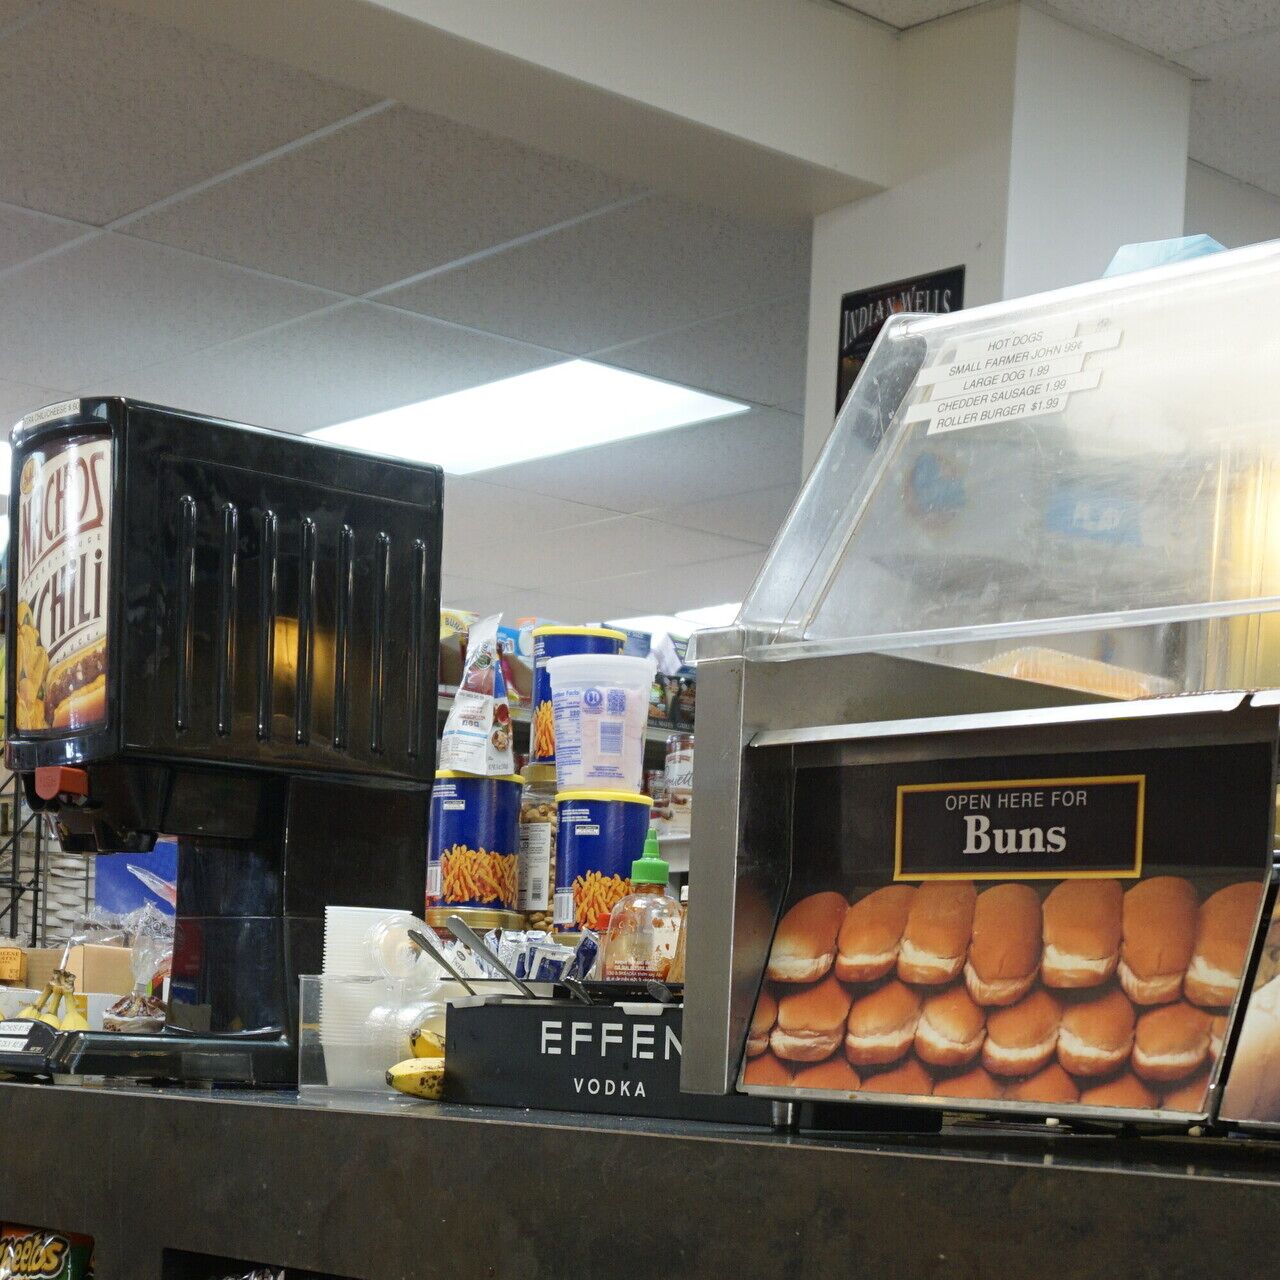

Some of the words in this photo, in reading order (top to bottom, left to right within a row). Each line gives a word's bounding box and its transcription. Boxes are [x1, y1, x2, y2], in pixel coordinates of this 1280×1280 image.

[843, 292, 898, 350] INDIAN
[900, 284, 953, 314] WELLS
[987, 336, 1011, 352] HOT
[1012, 331, 1044, 347] DOGS
[948, 361, 982, 377] SMALL
[984, 350, 1030, 370] FARMER
[1030, 345, 1062, 360] JOHN
[962, 376, 1001, 391] LARGE
[1002, 370, 1026, 383] DOG
[1029, 364, 1051, 378] 1.99
[936, 394, 989, 413] CHEDDER
[990, 385, 1042, 404] SAUSAGE
[1045, 379, 1067, 393] 1.99
[936, 411, 979, 430] ROLLER
[980, 404, 1026, 423] BURGER
[1031, 398, 1060, 411] $1.99
[945, 794, 1000, 811] OPEN
[1003, 792, 1048, 810] HERE
[1052, 789, 1088, 808] FOR
[962, 815, 1068, 855] Buns
[541, 1020, 683, 1060] EFFEN
[573, 1077, 646, 1099] VODKA
